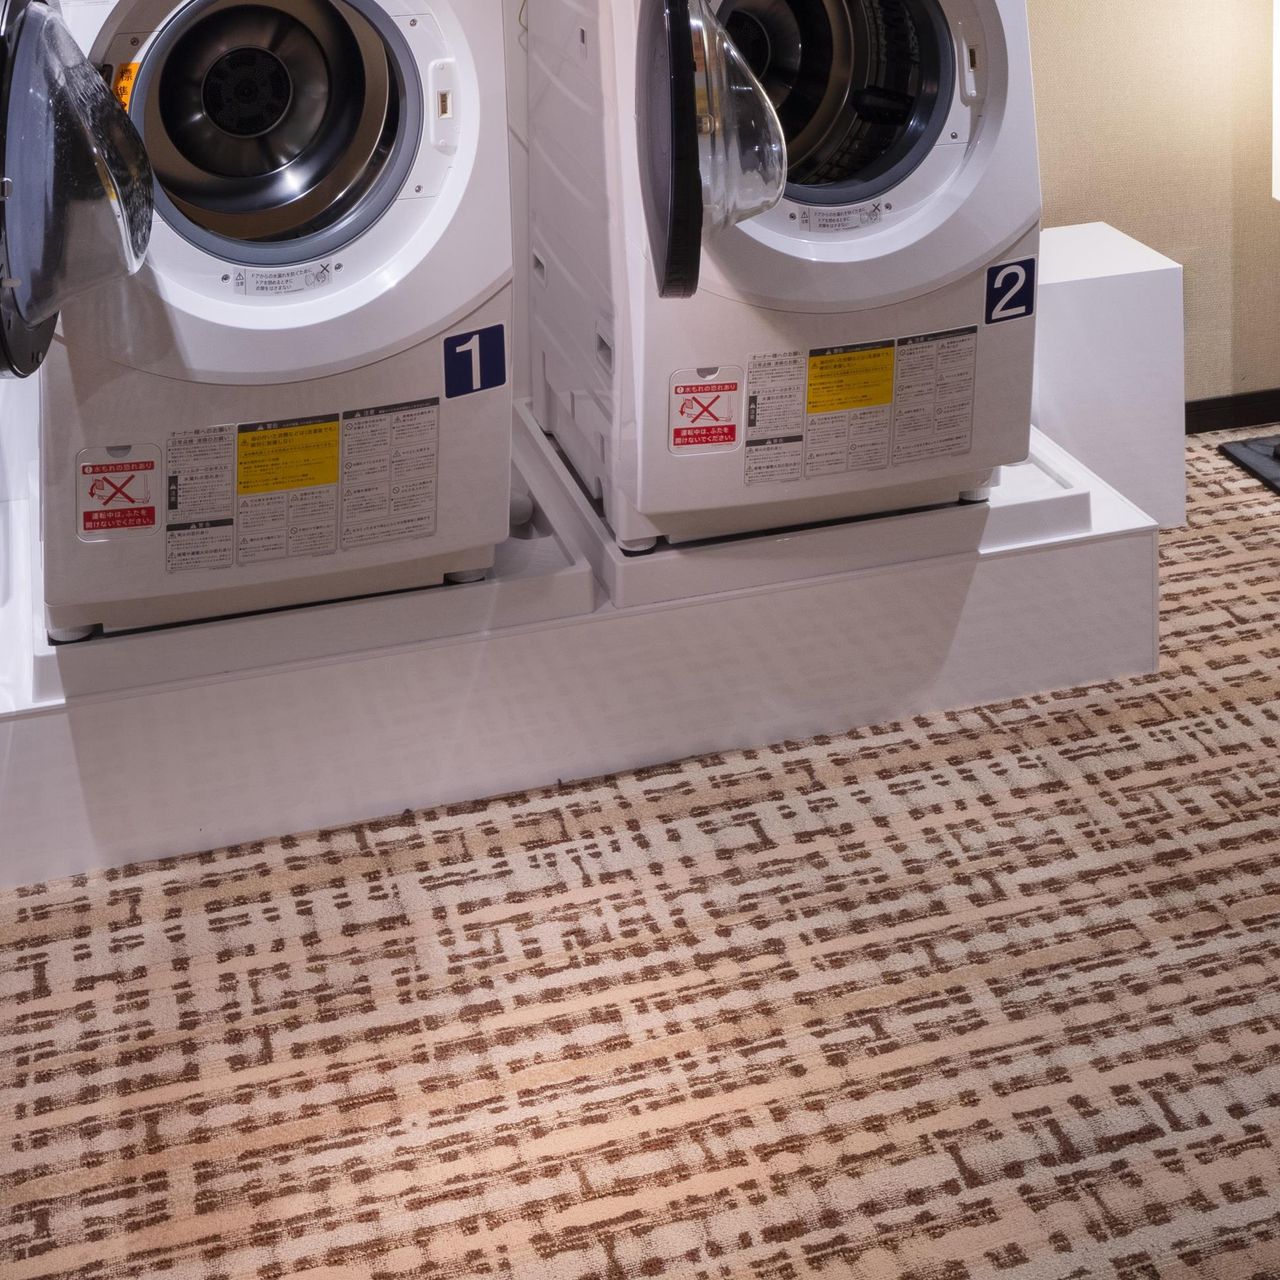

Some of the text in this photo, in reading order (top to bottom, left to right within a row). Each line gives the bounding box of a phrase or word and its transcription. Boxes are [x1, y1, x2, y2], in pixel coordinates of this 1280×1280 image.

[991, 265, 1026, 320] 2
[455, 334, 481, 390] 1
[685, 383, 737, 392] 水もれの恐れあり
[680, 427, 729, 436] 運転中は、ふたを
[675, 435, 734, 444] 開けないでください。
[93, 463, 153, 472] 水もれの恐れあり
[92, 509, 148, 520] 運転中は、ふたを
[85, 518, 154, 529] 開けないでください。
